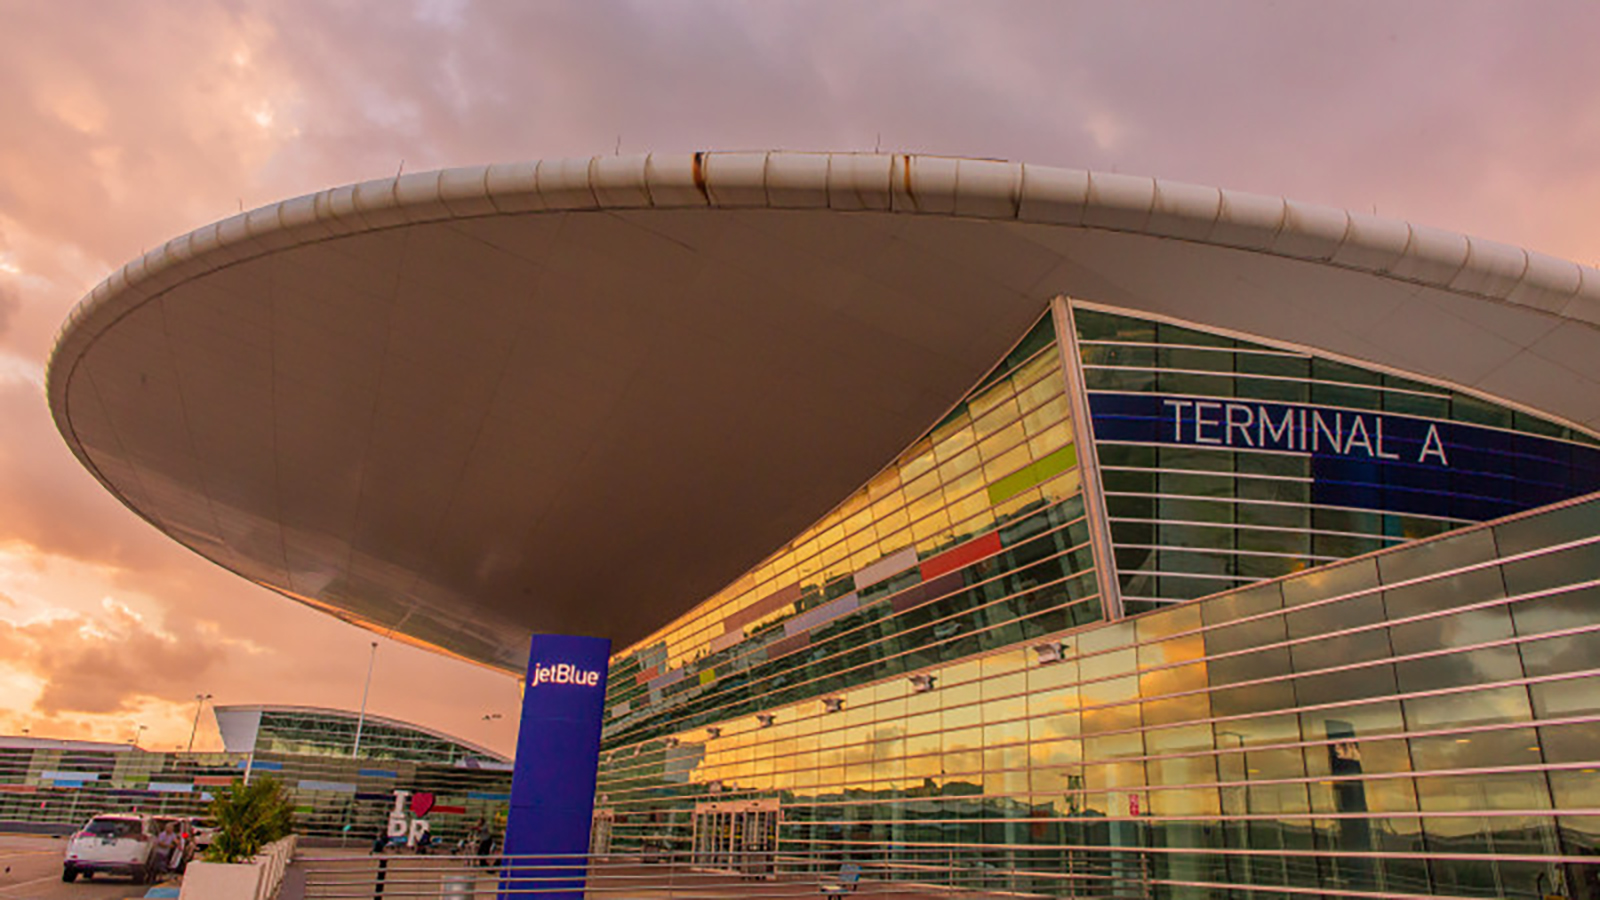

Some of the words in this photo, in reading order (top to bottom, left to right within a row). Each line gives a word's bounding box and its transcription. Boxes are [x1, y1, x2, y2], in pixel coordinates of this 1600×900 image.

[1163, 399, 1400, 460] TERMINAL
[1418, 423, 1449, 466] A
[531, 662, 600, 687] jetBlue
